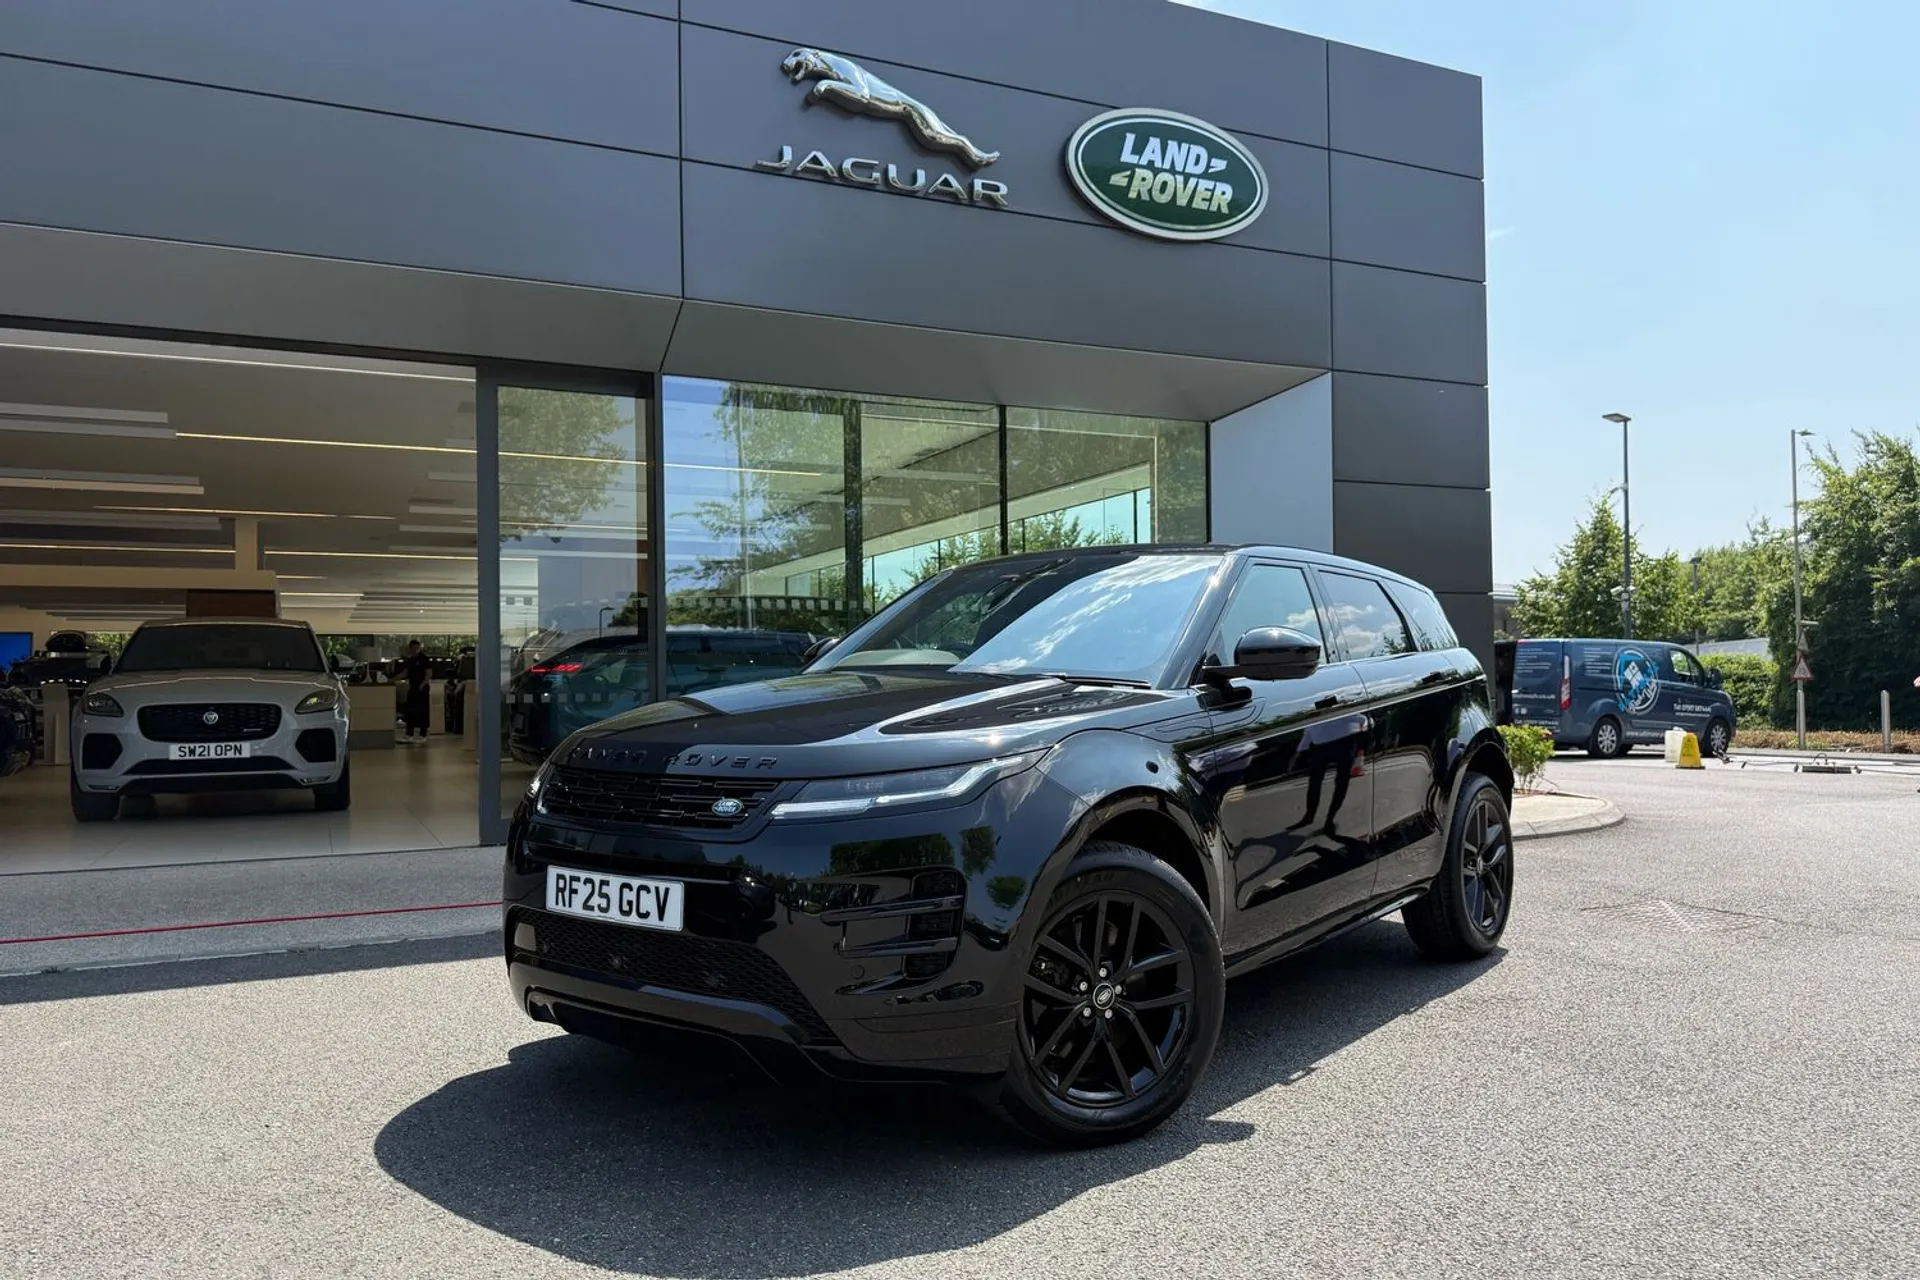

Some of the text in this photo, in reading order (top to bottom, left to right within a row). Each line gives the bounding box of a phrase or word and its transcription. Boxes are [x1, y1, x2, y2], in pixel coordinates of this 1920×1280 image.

[1120, 132, 1208, 174] LAND
[757, 145, 1008, 205] JAGUAR
[1128, 168, 1233, 213] ROVER
[178, 744, 242, 758] SW21 OPN
[663, 753, 778, 770] ROVER
[555, 873, 670, 922] RF25 GCV
